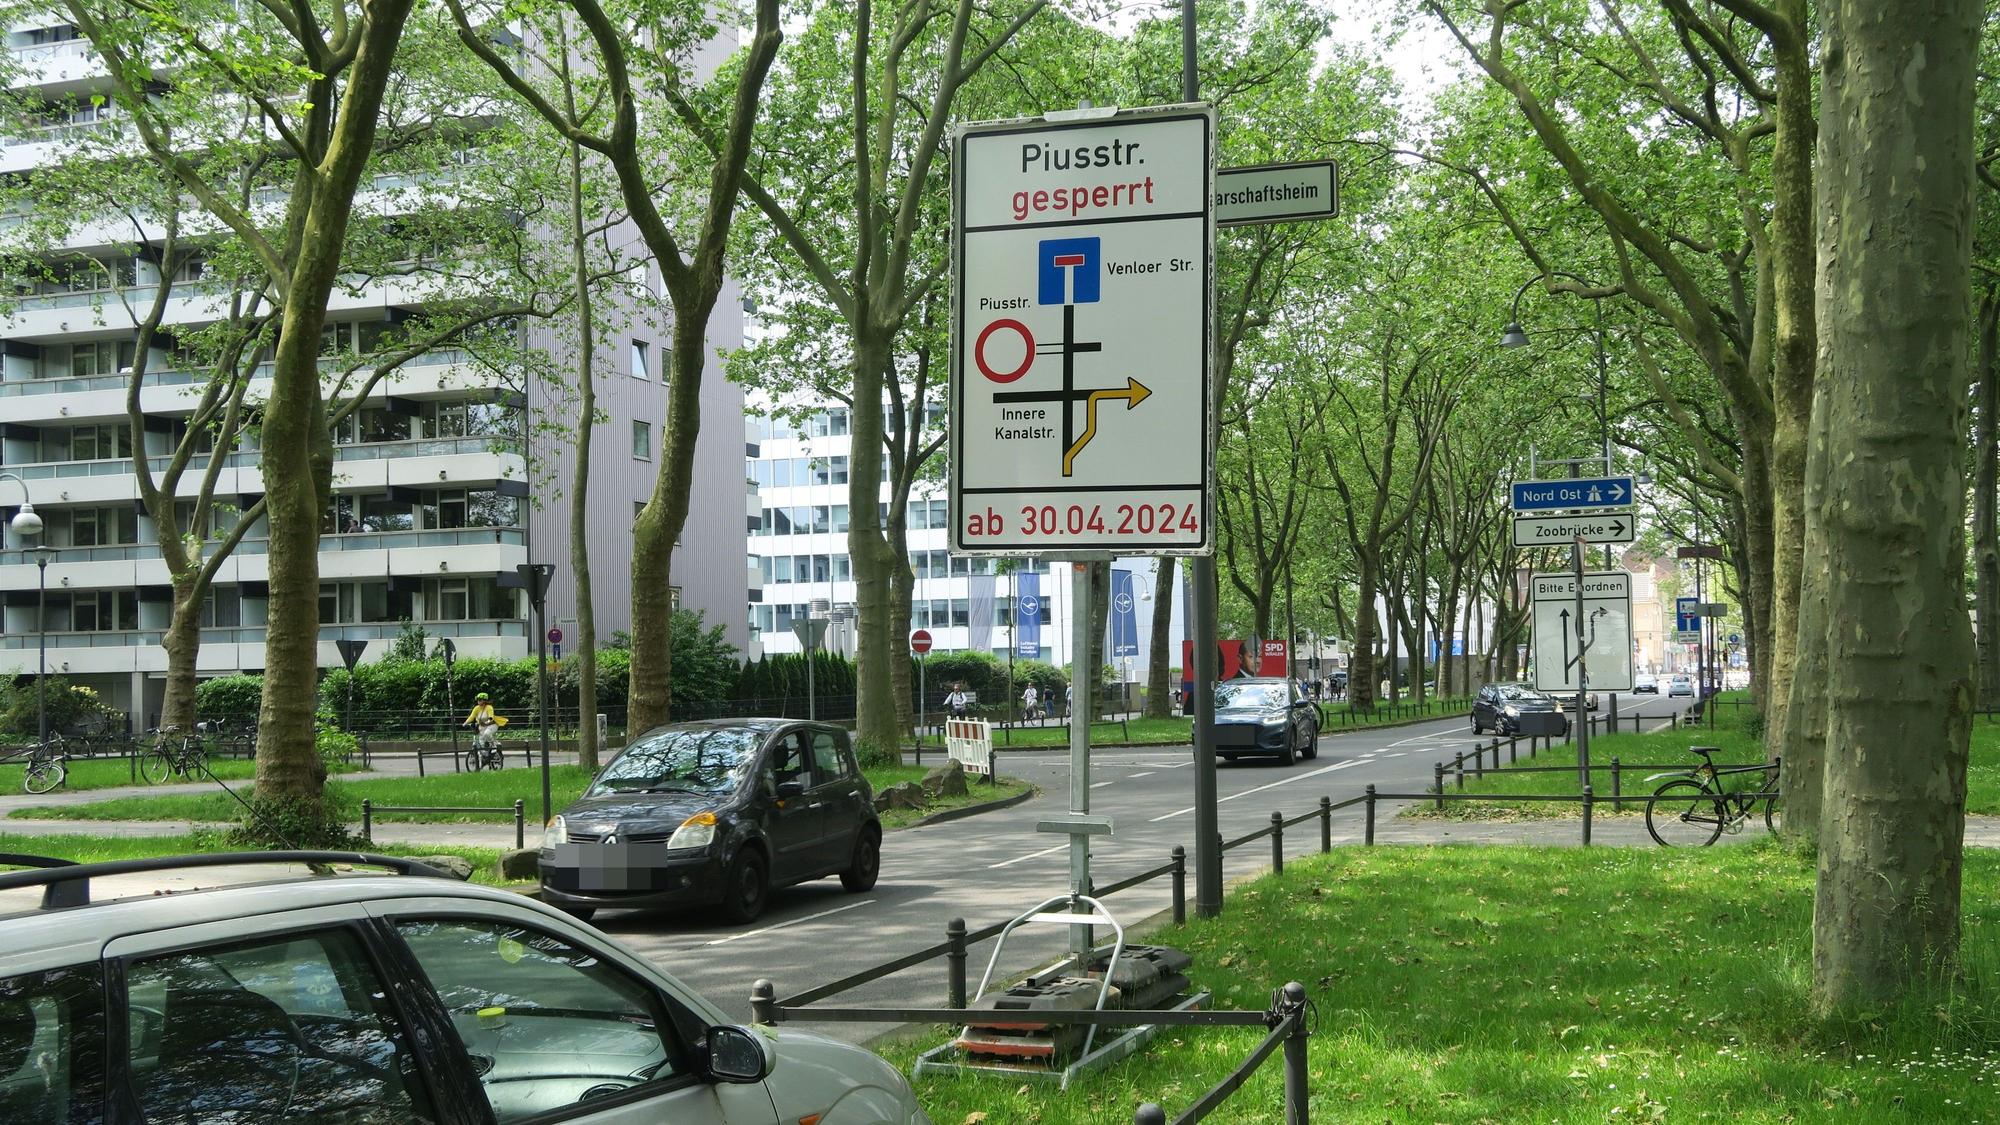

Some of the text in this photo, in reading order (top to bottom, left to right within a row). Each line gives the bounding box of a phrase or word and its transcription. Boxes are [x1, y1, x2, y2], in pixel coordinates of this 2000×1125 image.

[1021, 139, 1146, 173] Piusstr.
[1011, 176, 1154, 221] gesperrt
[1217, 182, 1319, 206] arschaftsheim
[1107, 258, 1195, 275] Venloer Str.
[979, 296, 1032, 310] Piusstr.
[1001, 407, 1046, 421] Innere
[994, 426, 1056, 440] Kanalstr.
[1523, 488, 1581, 502] Nord Ost
[967, 503, 1198, 536] ab 30.04.2024
[1535, 524, 1603, 537] Zoobrücke
[1539, 582, 1622, 594] Bitte Eordnen
[1265, 643, 1284, 651] SPD
